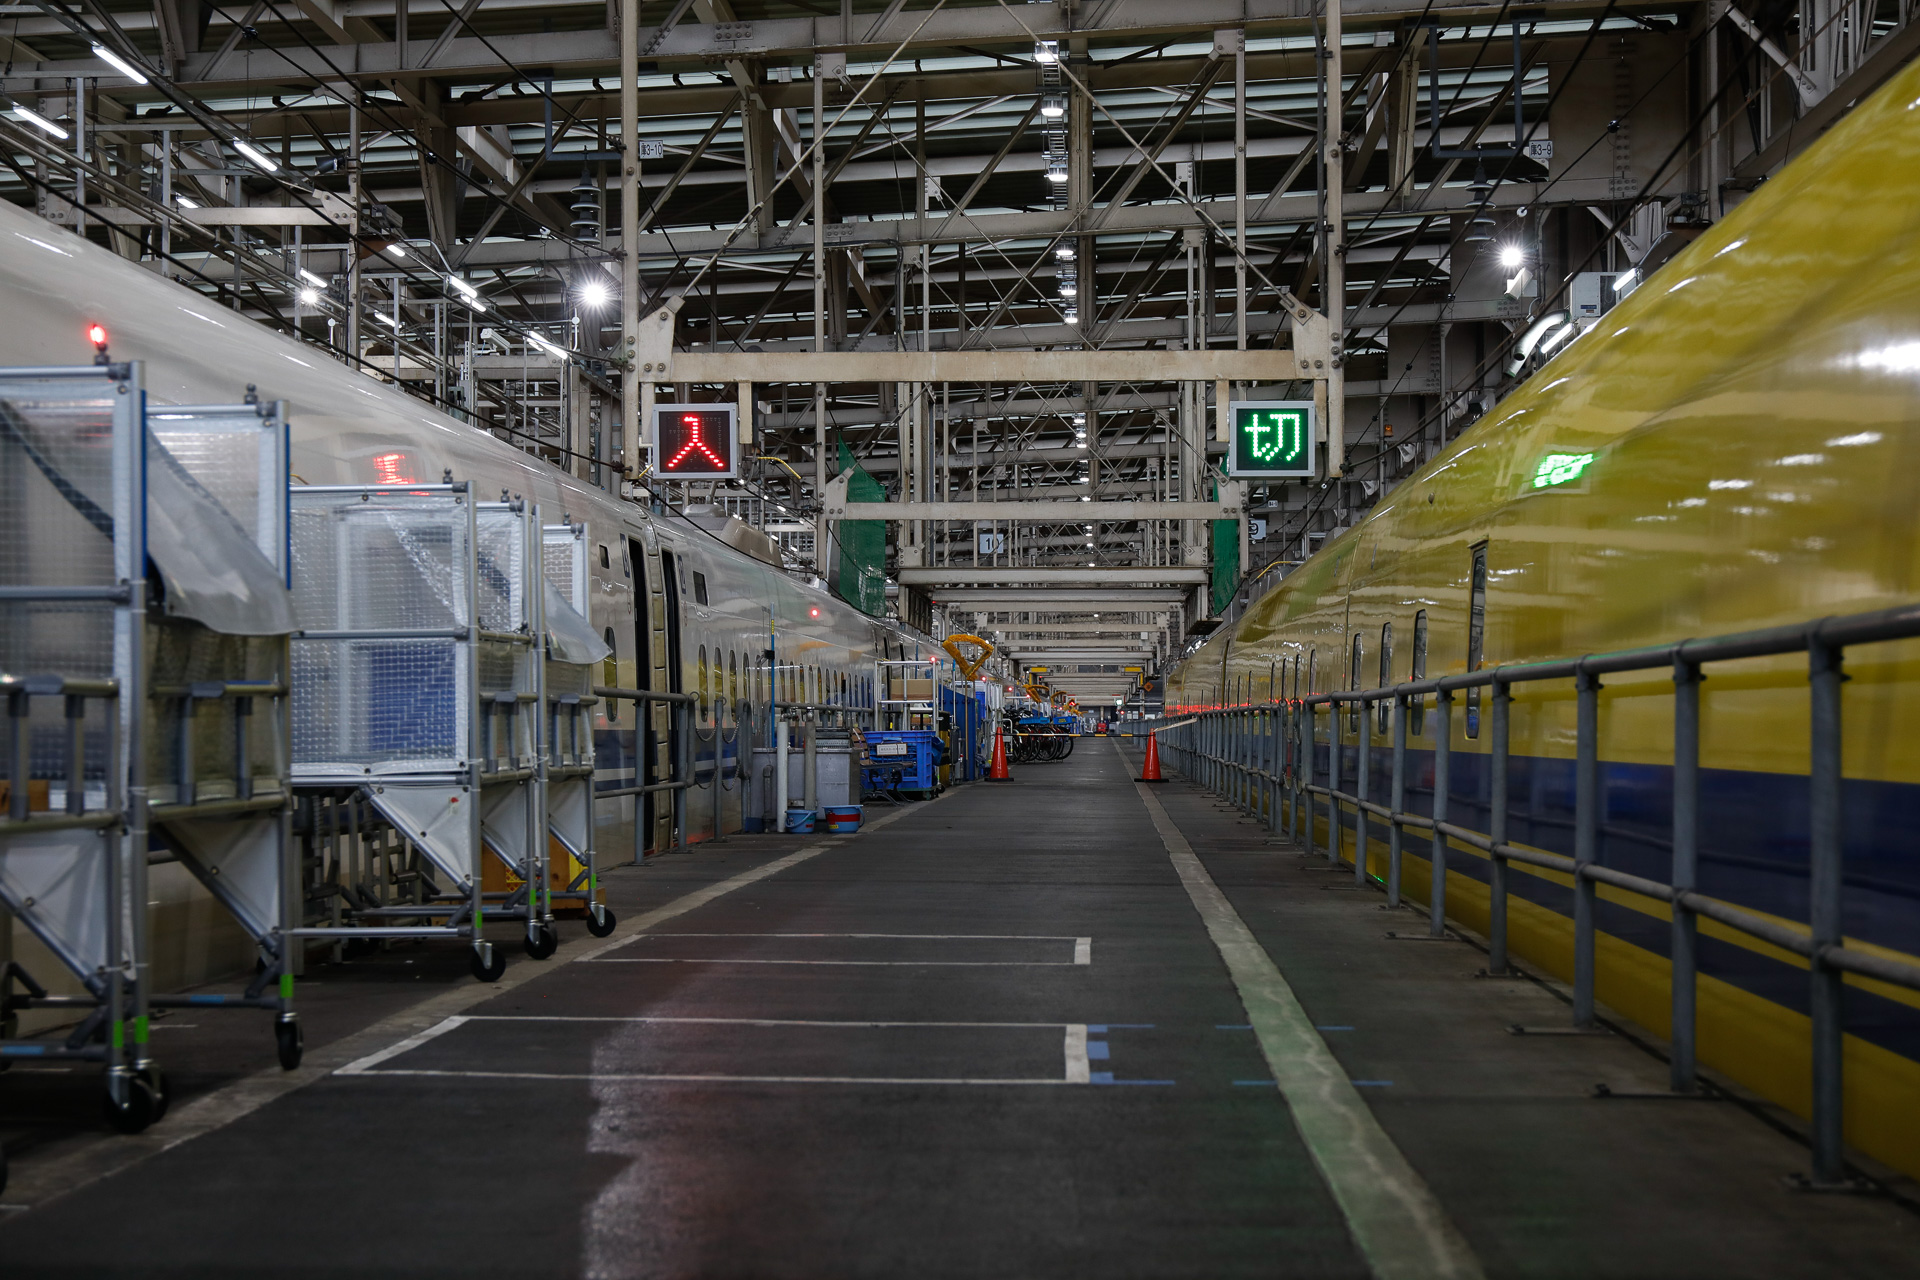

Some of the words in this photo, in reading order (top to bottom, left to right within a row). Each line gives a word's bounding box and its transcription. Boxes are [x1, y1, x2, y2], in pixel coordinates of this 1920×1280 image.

[641, 143, 662, 155] 庫3-10
[1531, 143, 1551, 155] 庫3-9
[667, 416, 724, 468] 入
[1244, 413, 1301, 462] 切
[985, 538, 1000, 550] 10
